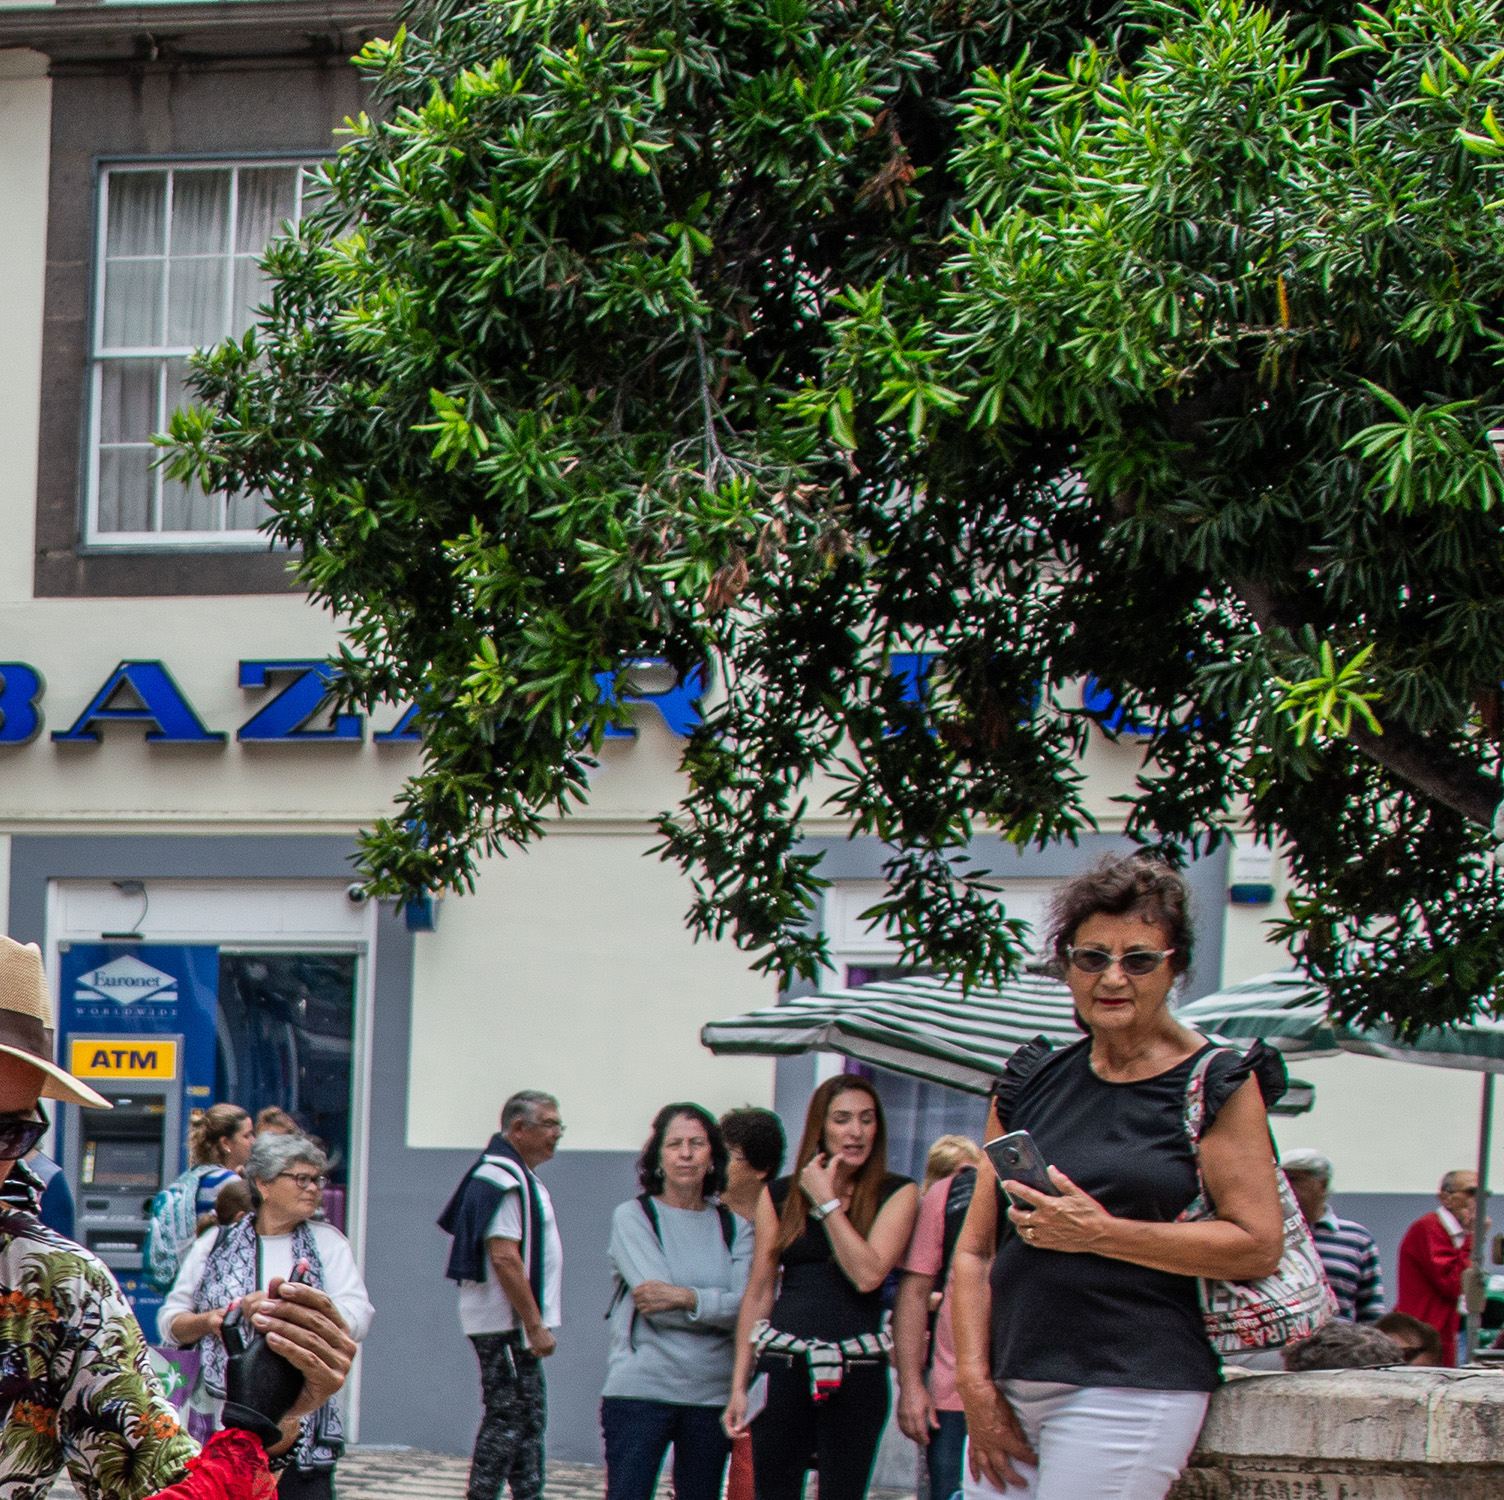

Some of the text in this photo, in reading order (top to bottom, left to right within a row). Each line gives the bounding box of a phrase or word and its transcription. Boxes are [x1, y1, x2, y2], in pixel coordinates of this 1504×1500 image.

[91, 970, 162, 988] Euronet
[75, 1006, 178, 1017] WORLDWIDE
[90, 1049, 159, 1070] ATM
